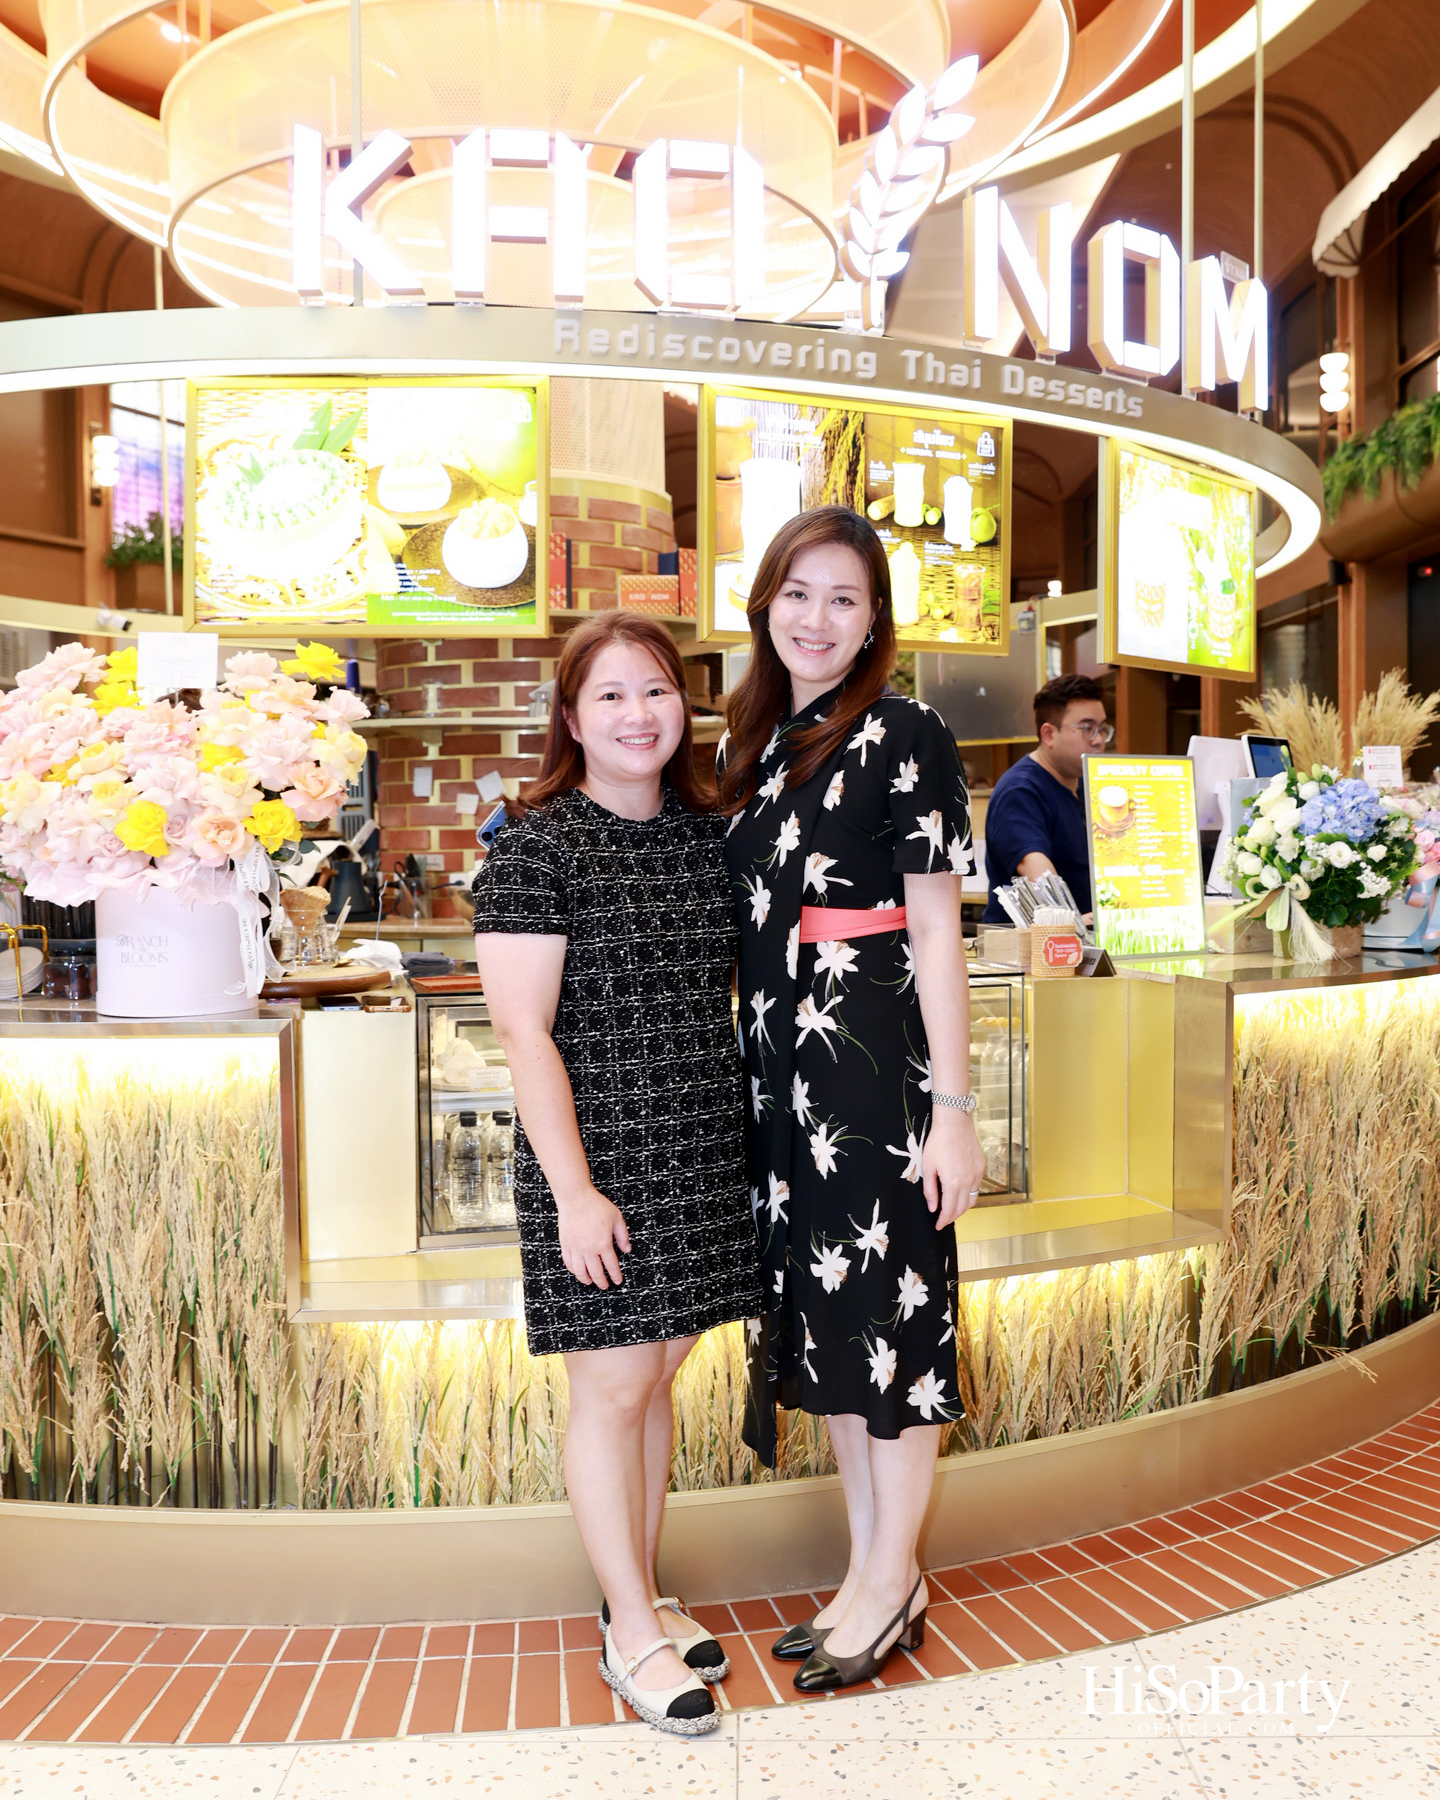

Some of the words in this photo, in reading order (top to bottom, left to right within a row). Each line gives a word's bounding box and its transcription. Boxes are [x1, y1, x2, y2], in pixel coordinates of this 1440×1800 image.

[294, 123, 765, 312] KAO
[964, 185, 1269, 412] NOM
[554, 317, 878, 379] Rediscovering
[901, 349, 982, 389] Thai
[1002, 363, 1144, 418] Desserts
[115, 934, 168, 951] BRANCH
[120, 951, 169, 964] BLOOMS
